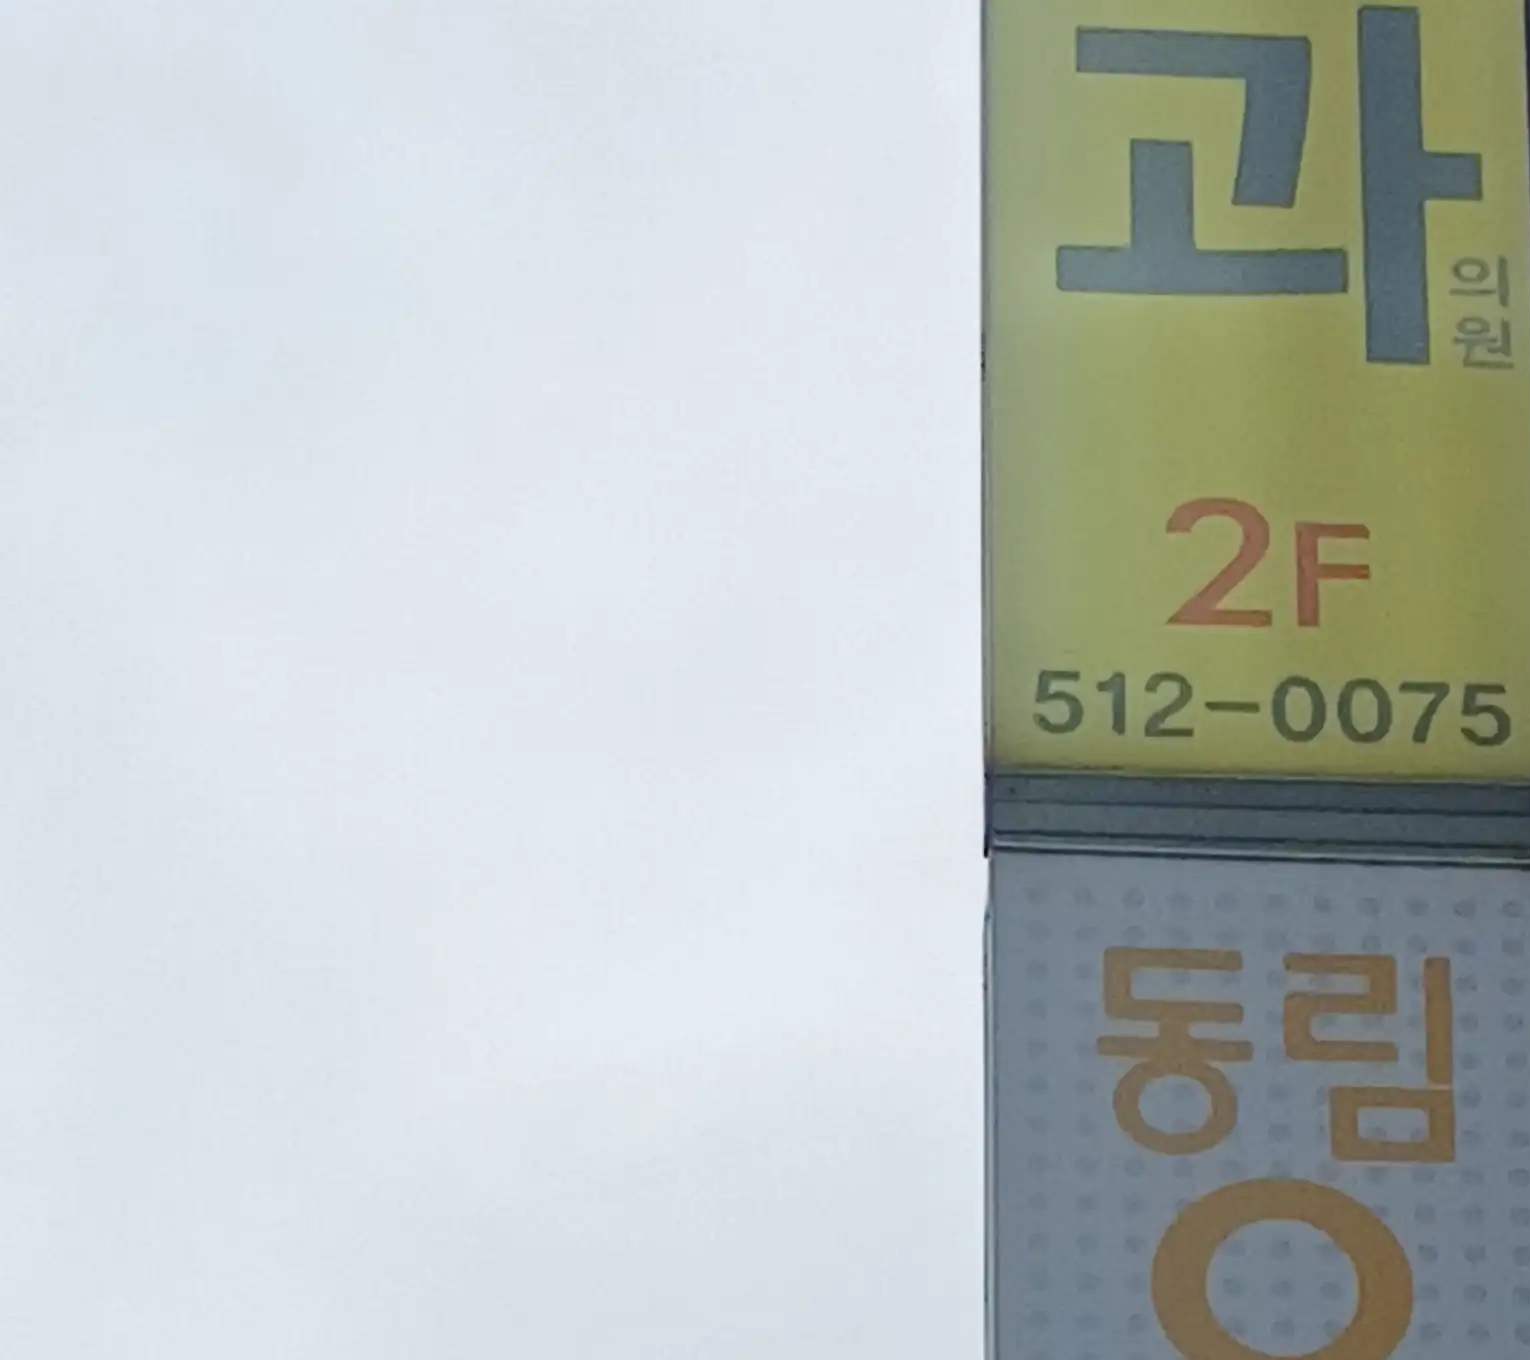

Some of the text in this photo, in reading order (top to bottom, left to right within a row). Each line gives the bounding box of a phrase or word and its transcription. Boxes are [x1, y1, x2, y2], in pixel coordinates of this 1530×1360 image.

[1056, 5, 1482, 366] 과
[1448, 255, 1514, 370] 의원
[1164, 497, 1371, 628] 2F
[1033, 669, 1513, 747] 512-0075
[1097, 946, 1456, 1163] 동림
